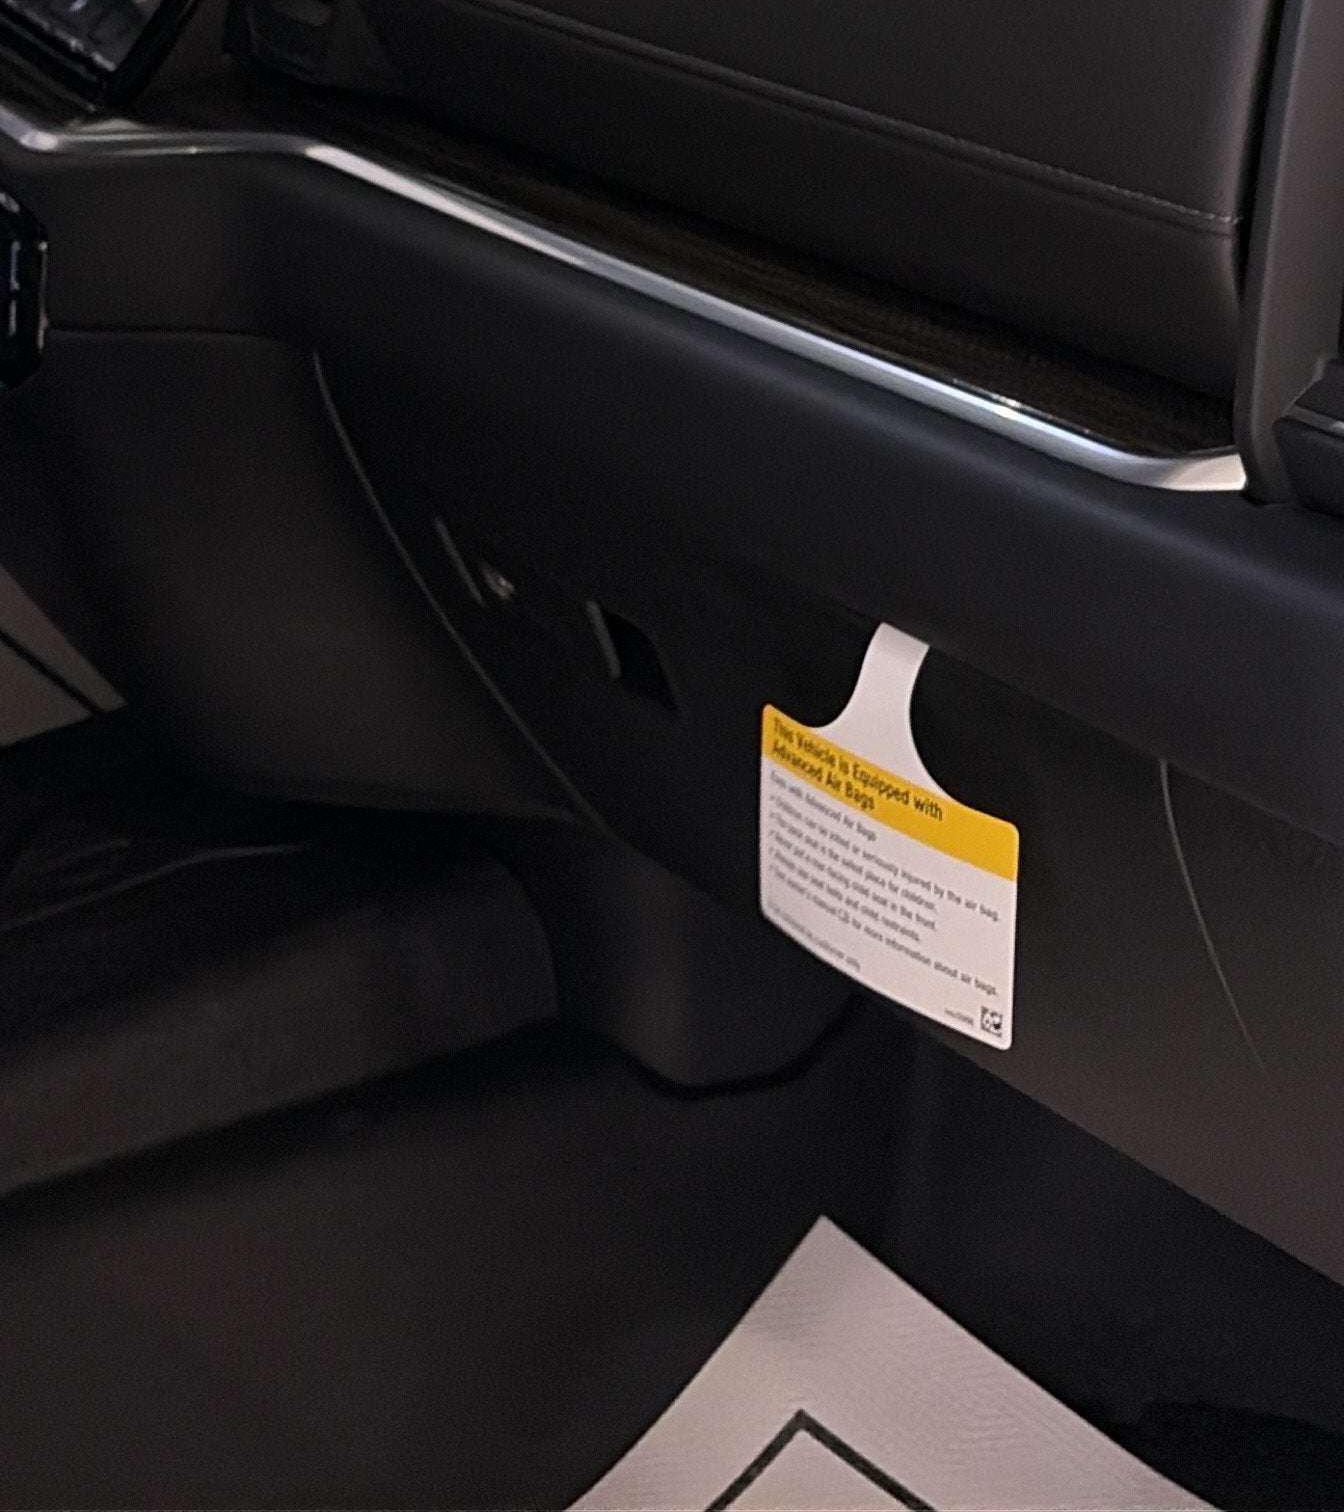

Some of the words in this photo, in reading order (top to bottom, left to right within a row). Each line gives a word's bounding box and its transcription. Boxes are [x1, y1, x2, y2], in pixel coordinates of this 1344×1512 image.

[826, 769, 841, 792] Air
[845, 779, 874, 814] Bags
[852, 760, 909, 810] Equipped
[914, 791, 942, 822] with
[964, 897, 976, 911] air
[960, 970, 972, 985] air
